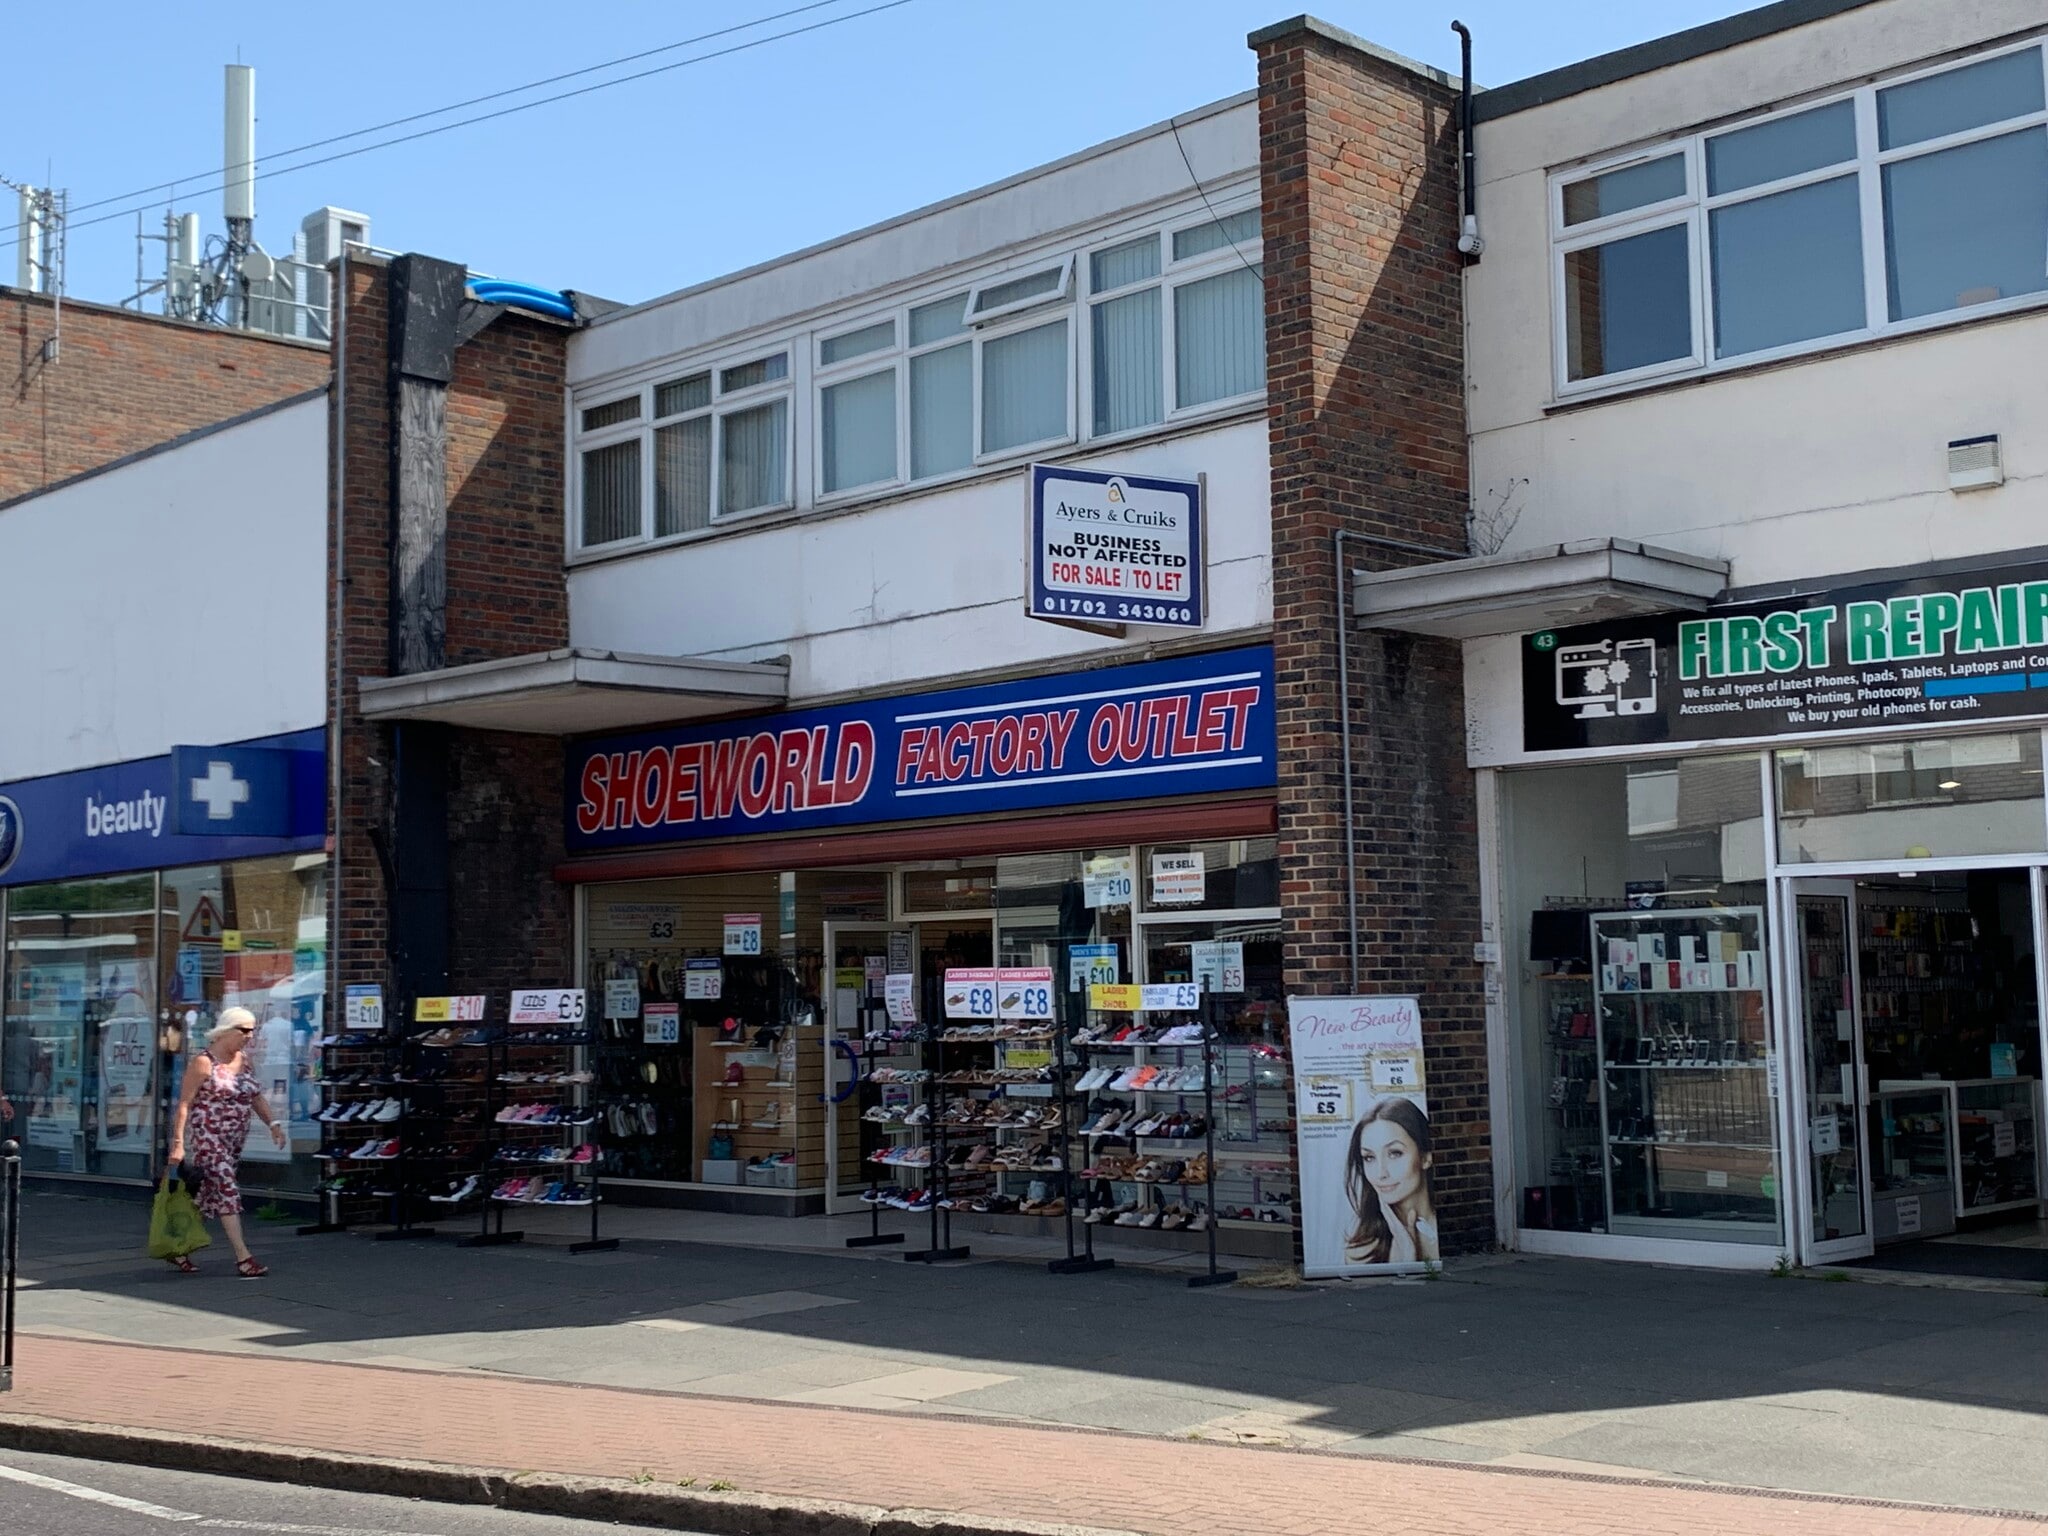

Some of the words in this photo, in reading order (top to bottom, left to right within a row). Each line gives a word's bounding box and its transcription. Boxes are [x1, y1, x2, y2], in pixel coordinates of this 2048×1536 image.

[1056, 501, 1100, 521] Ayers
[1107, 510, 1118, 521] &
[1124, 508, 1176, 528] Cruiks
[1074, 532, 1161, 551] BUSINESS
[1048, 544, 1088, 559] NOT
[1094, 549, 1187, 567] AFFECTED
[1052, 563, 1080, 583] FOR
[1085, 566, 1121, 587] SALE
[1133, 569, 1150, 589] TO
[1156, 571, 1182, 592] LET
[1044, 597, 1106, 615] 01702
[1118, 603, 1191, 622] 343060
[1536, 634, 1554, 648] 43
[1677, 605, 1836, 680] FIRST
[1683, 687, 1700, 699] We
[1701, 686, 1716, 697] fix
[1717, 684, 1732, 696] all
[1734, 684, 1764, 698] types
[1766, 680, 1779, 691] of
[1780, 678, 1813, 690] latest
[1815, 674, 1859, 688] Phones,
[1862, 670, 1898, 686] Ipads,
[1901, 666, 1947, 680] Tablets,
[1950, 660, 1999, 676] Laptops
[2002, 656, 2026, 670] and
[1679, 700, 1743, 715] Accessories,
[1746, 696, 1803, 710] Unlocking,
[1806, 691, 1855, 705] Printing,
[1857, 685, 1922, 701] Photocopy,
[1787, 711, 1805, 723] We
[1808, 709, 1830, 722] buy
[1832, 707, 1859, 722] your
[1861, 704, 1880, 716] old
[1883, 702, 1926, 718] phones
[1929, 699, 1948, 711] for
[1950, 696, 1981, 709] cash.
[895, 708, 1080, 785] FACTORY
[1088, 686, 1261, 766] OUTLET
[577, 720, 876, 834] SHOEWORLD
[85, 789, 166, 838] beauty
[1161, 861, 1174, 869] WE
[1175, 860, 1195, 869] SELL
[1109, 878, 1131, 897] £10
[650, 922, 673, 938] £3
[743, 930, 758, 952] £8
[1090, 967, 1115, 984] £10
[1224, 969, 1241, 987] £5
[704, 978, 719, 996] £6
[1102, 986, 1128, 995] LADIES
[1176, 986, 1196, 1006] £5
[457, 996, 481, 1020] £10
[521, 994, 547, 1007] KIDS
[558, 994, 584, 1019] £5
[622, 997, 637, 1011] £10
[970, 988, 992, 1014] £8
[1024, 988, 1048, 1014] £8
[1102, 1000, 1128, 1008] SHOES
[360, 1006, 379, 1023] £10
[1297, 1015, 1345, 1038] New
[1350, 1006, 1412, 1036] Beauty
[662, 1019, 676, 1040] £8
[113, 1045, 146, 1065] PRICE
[1390, 1077, 1403, 1085] £6
[1317, 1102, 1336, 1114] £5
